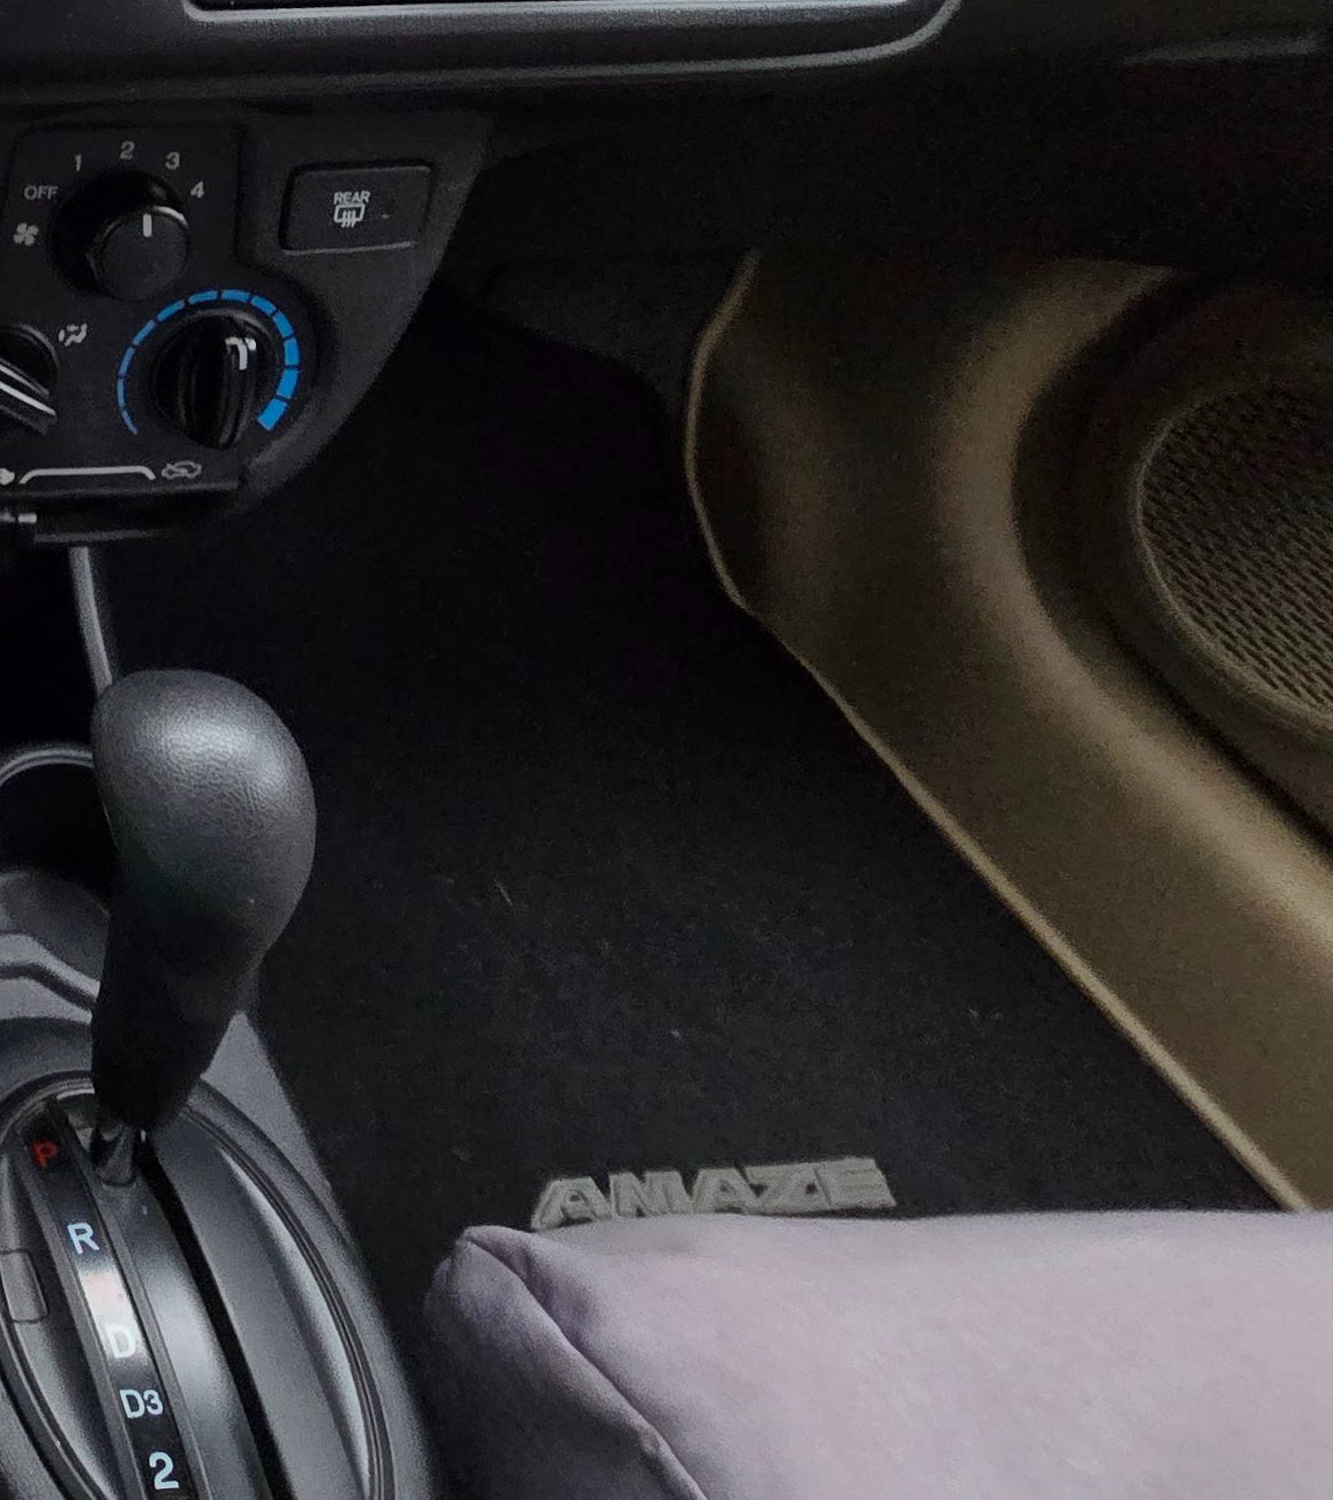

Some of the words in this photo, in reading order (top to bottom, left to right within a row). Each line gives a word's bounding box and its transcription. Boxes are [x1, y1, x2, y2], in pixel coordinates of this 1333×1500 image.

[120, 141, 136, 160] 2
[74, 155, 83, 171] 1
[165, 152, 181, 170] 3
[23, 185, 59, 202] OFF
[190, 181, 206, 198] 4
[333, 190, 371, 205] REAR
[67, 1222, 100, 1254] R
[105, 1327, 136, 1358] D
[119, 1389, 164, 1419] D3
[148, 1452, 179, 1490] 2
